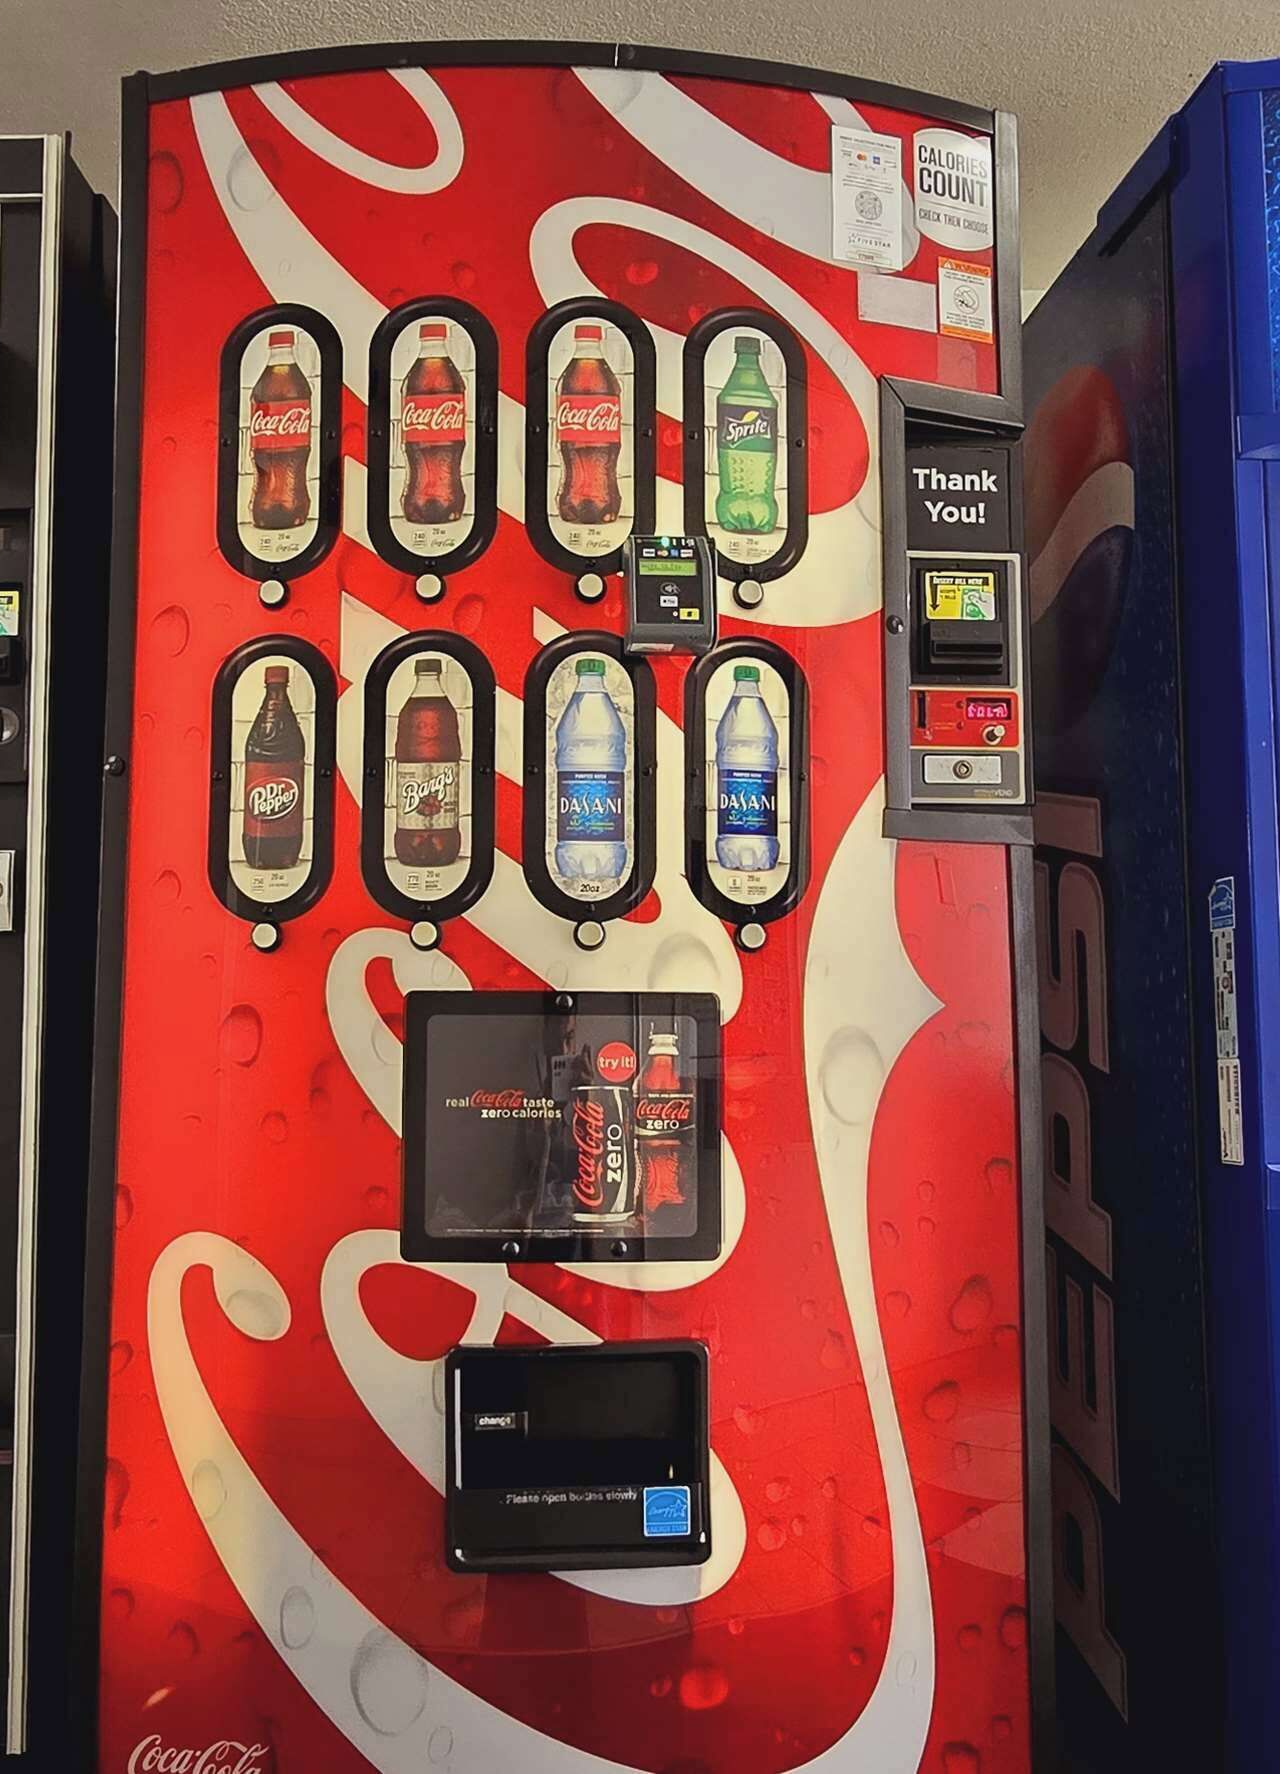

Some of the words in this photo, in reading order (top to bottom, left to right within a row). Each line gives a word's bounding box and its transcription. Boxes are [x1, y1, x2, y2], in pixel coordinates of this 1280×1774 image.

[918, 144, 988, 179] CALORIES
[919, 167, 988, 208] COUNT
[918, 207, 942, 223] CHECK
[251, 407, 311, 436] Coca-Cola
[402, 401, 465, 431] Coca-Cola
[558, 401, 621, 433] Coca-Cola
[725, 419, 769, 440] Sprite
[912, 467, 998, 492] Thank
[925, 501, 986, 524] You!
[250, 786, 296, 814] Pepper
[266, 783, 286, 799] Dr
[402, 767, 455, 815] Barq's
[720, 788, 776, 813] DASANI
[560, 791, 622, 816] DASANI
[579, 882, 600, 894] 20oz
[598, 1055, 619, 1073] try
[620, 1054, 636, 1069] it!
[446, 1097, 469, 1108] real
[470, 1088, 527, 1108] Coca-Cola
[523, 1097, 555, 1108] taste
[636, 1099, 690, 1120] Coca-Cola
[481, 1109, 511, 1118] zero
[512, 1108, 562, 1119] calories
[646, 1119, 680, 1131] zero
[572, 1098, 604, 1208] Coca-Cola
[606, 1124, 623, 1184] zero
[478, 1416, 512, 1427] change
